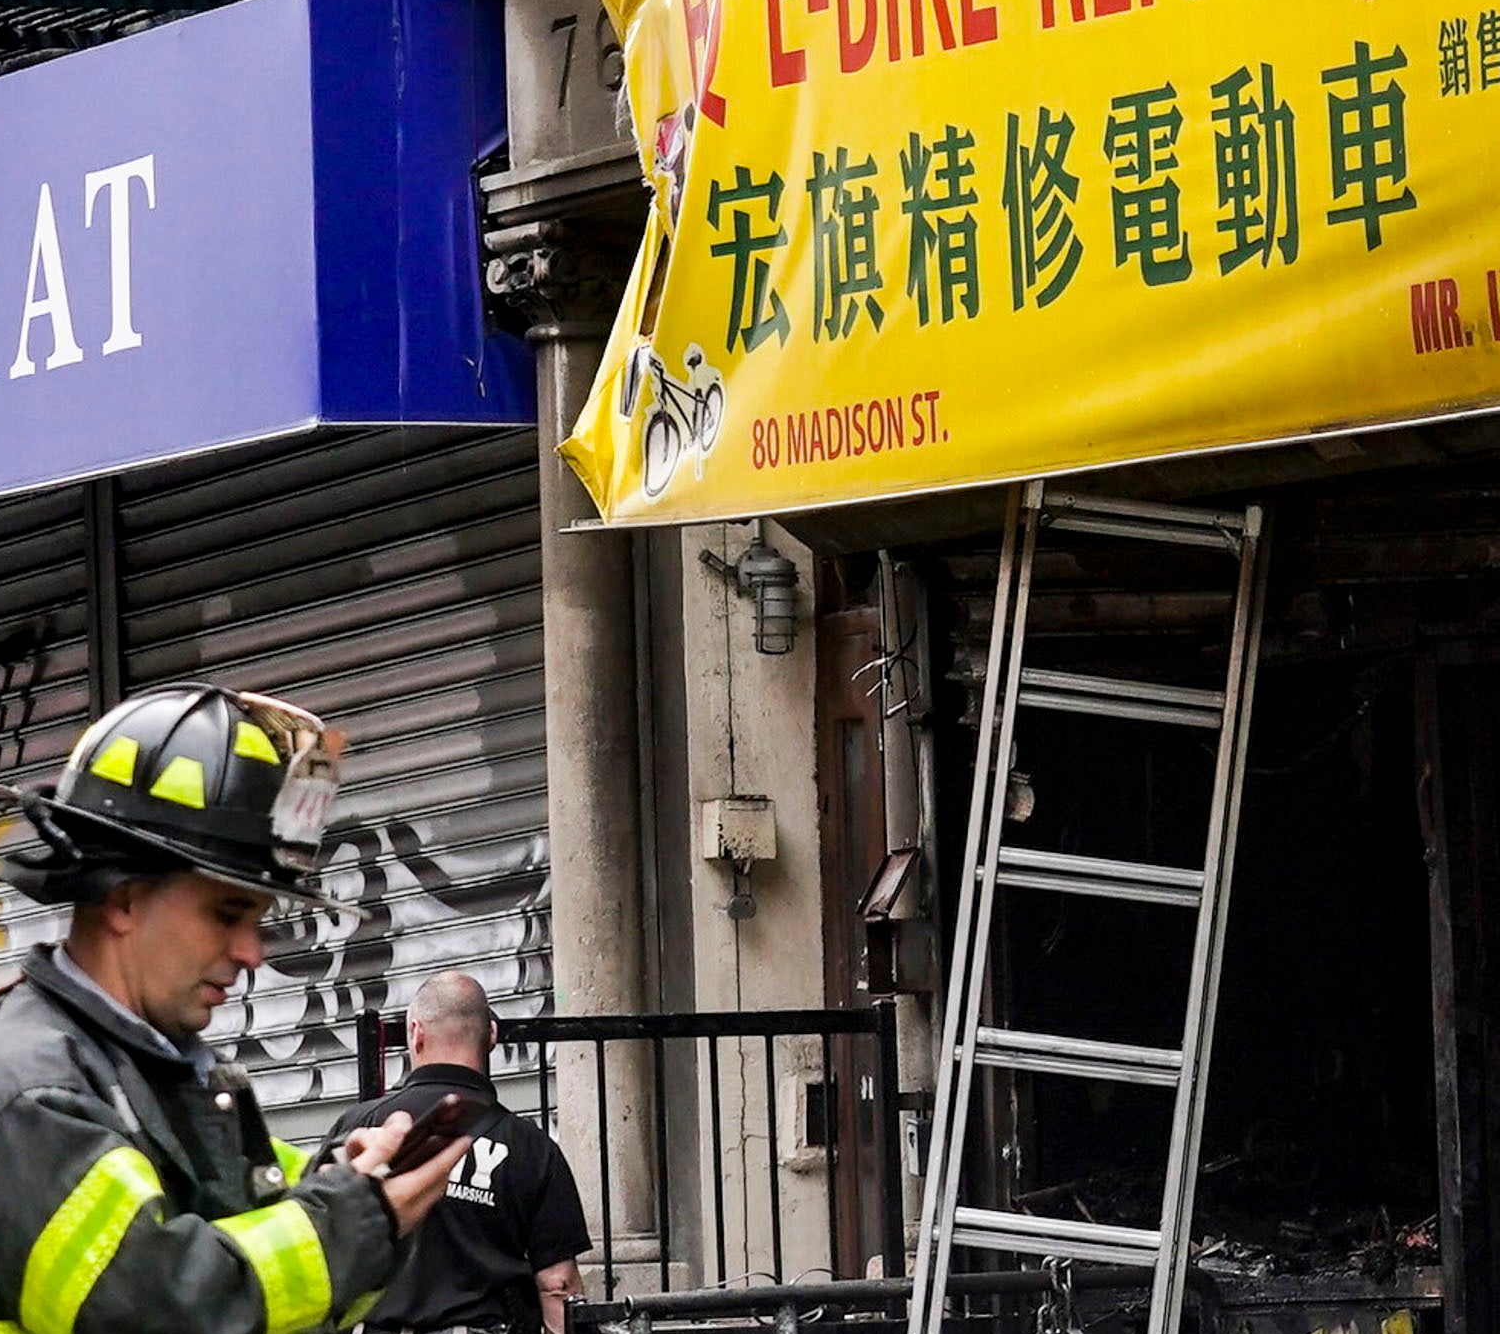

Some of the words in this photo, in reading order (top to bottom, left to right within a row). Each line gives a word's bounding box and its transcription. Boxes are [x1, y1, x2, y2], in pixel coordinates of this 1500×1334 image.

[705, 40, 1418, 356] 宏旗精修電動車
[1409, 277, 1474, 355] MR.
[751, 418, 781, 471] 80
[786, 395, 907, 465] MADISON
[909, 390, 949, 450] ST.
[445, 1182, 497, 1208] MARSHAL
